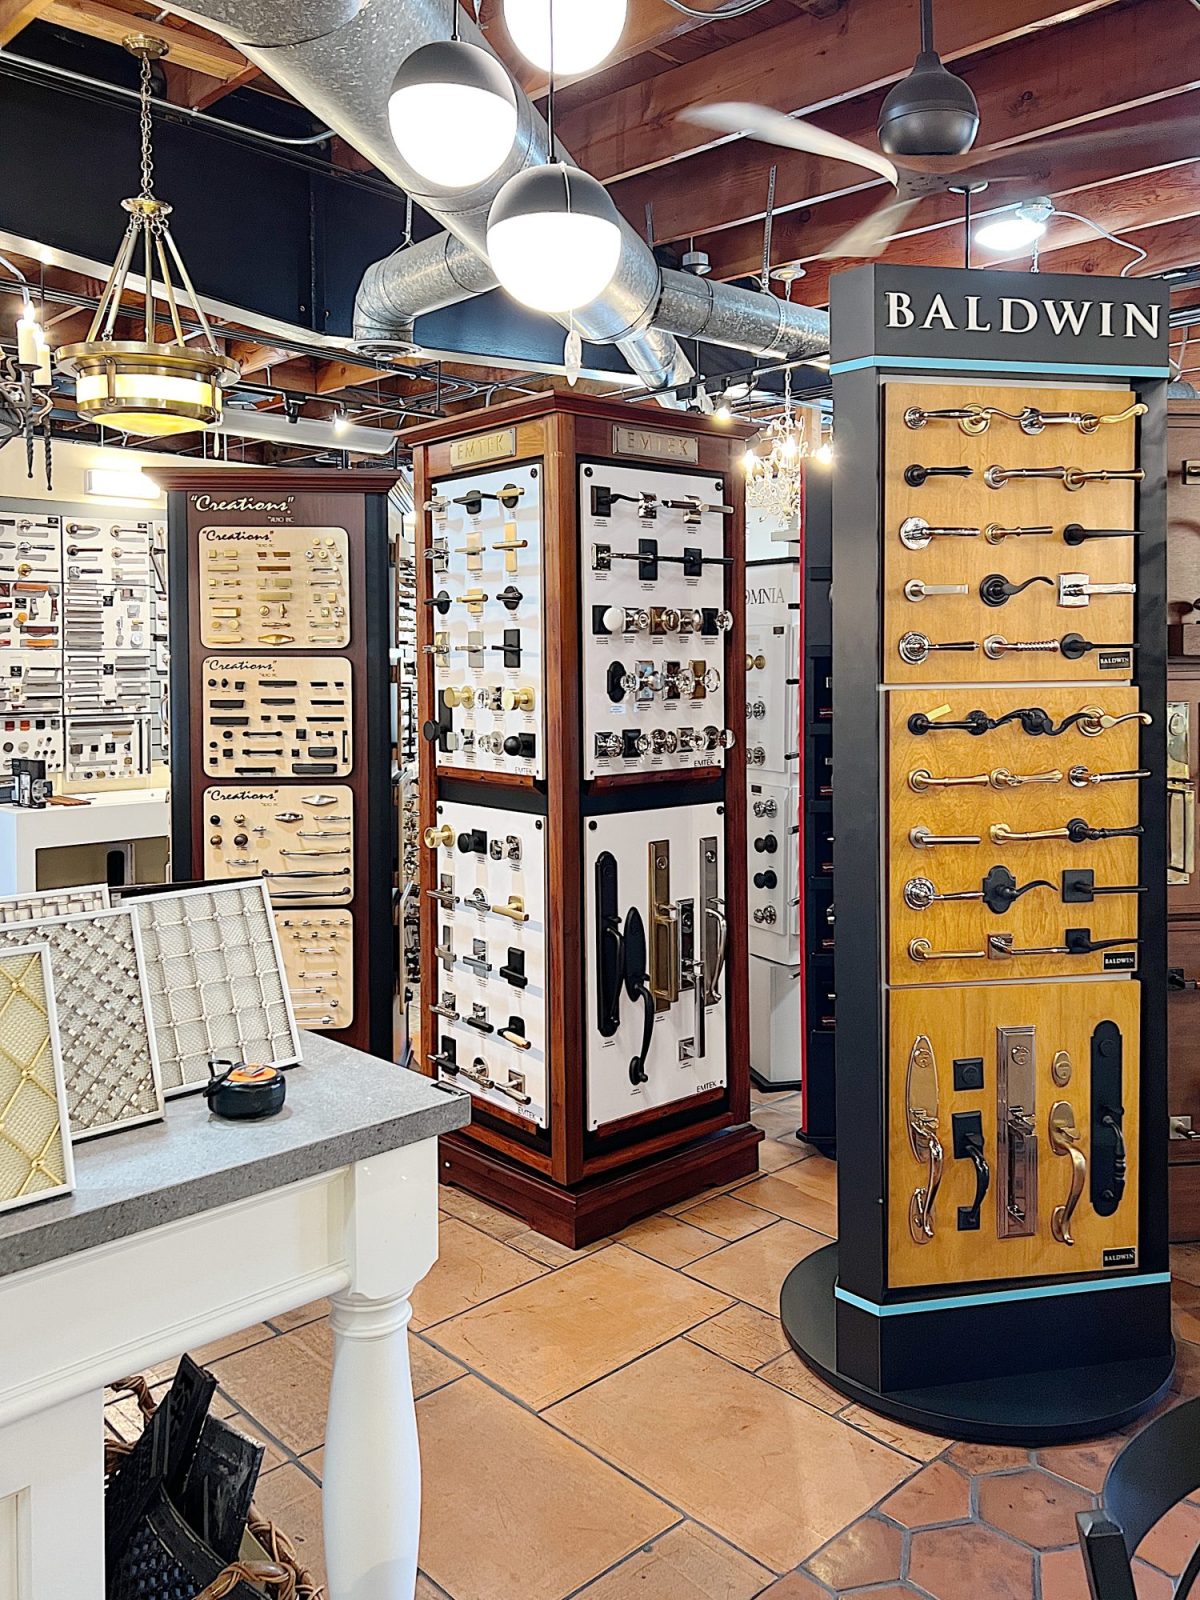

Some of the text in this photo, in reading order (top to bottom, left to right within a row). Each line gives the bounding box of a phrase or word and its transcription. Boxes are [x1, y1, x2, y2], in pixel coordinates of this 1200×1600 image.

[885, 291, 1161, 339] BALDWIN
[457, 434, 505, 460] EMTEK
[627, 431, 689, 456] EMTEK
[1100, 656, 1130, 665] BALDWIN
[694, 759, 715, 767] EMTEK
[1105, 956, 1134, 965] BALDWIN
[696, 1080, 717, 1093] EMTEK
[1104, 1253, 1135, 1262] BALDWIN
